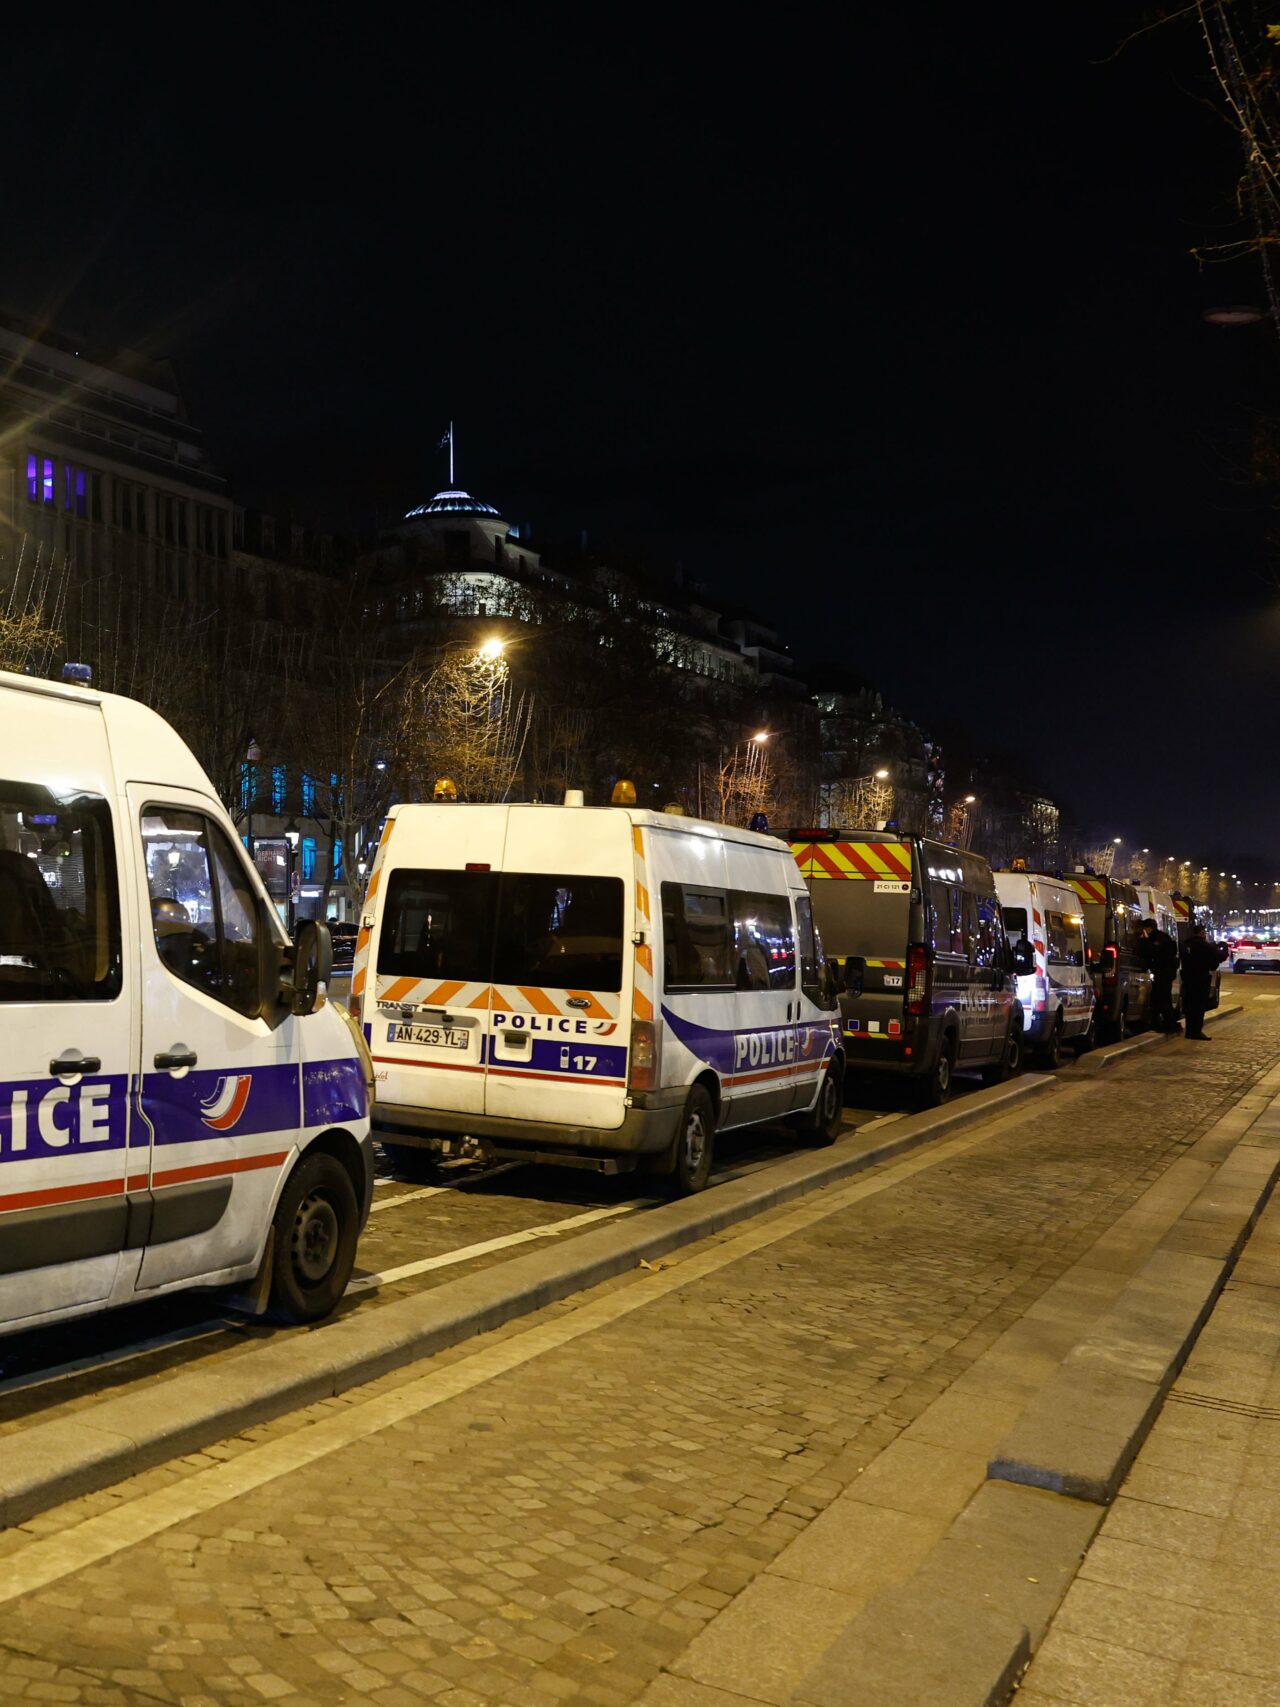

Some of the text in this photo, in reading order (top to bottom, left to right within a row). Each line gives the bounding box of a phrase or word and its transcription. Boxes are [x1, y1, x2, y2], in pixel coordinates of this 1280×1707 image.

[891, 977, 900, 985] 17
[376, 1000, 420, 1012] TRANSIT
[493, 1013, 588, 1034] POLICE
[735, 1029, 794, 1069] POLICE
[573, 1055, 598, 1071] 17
